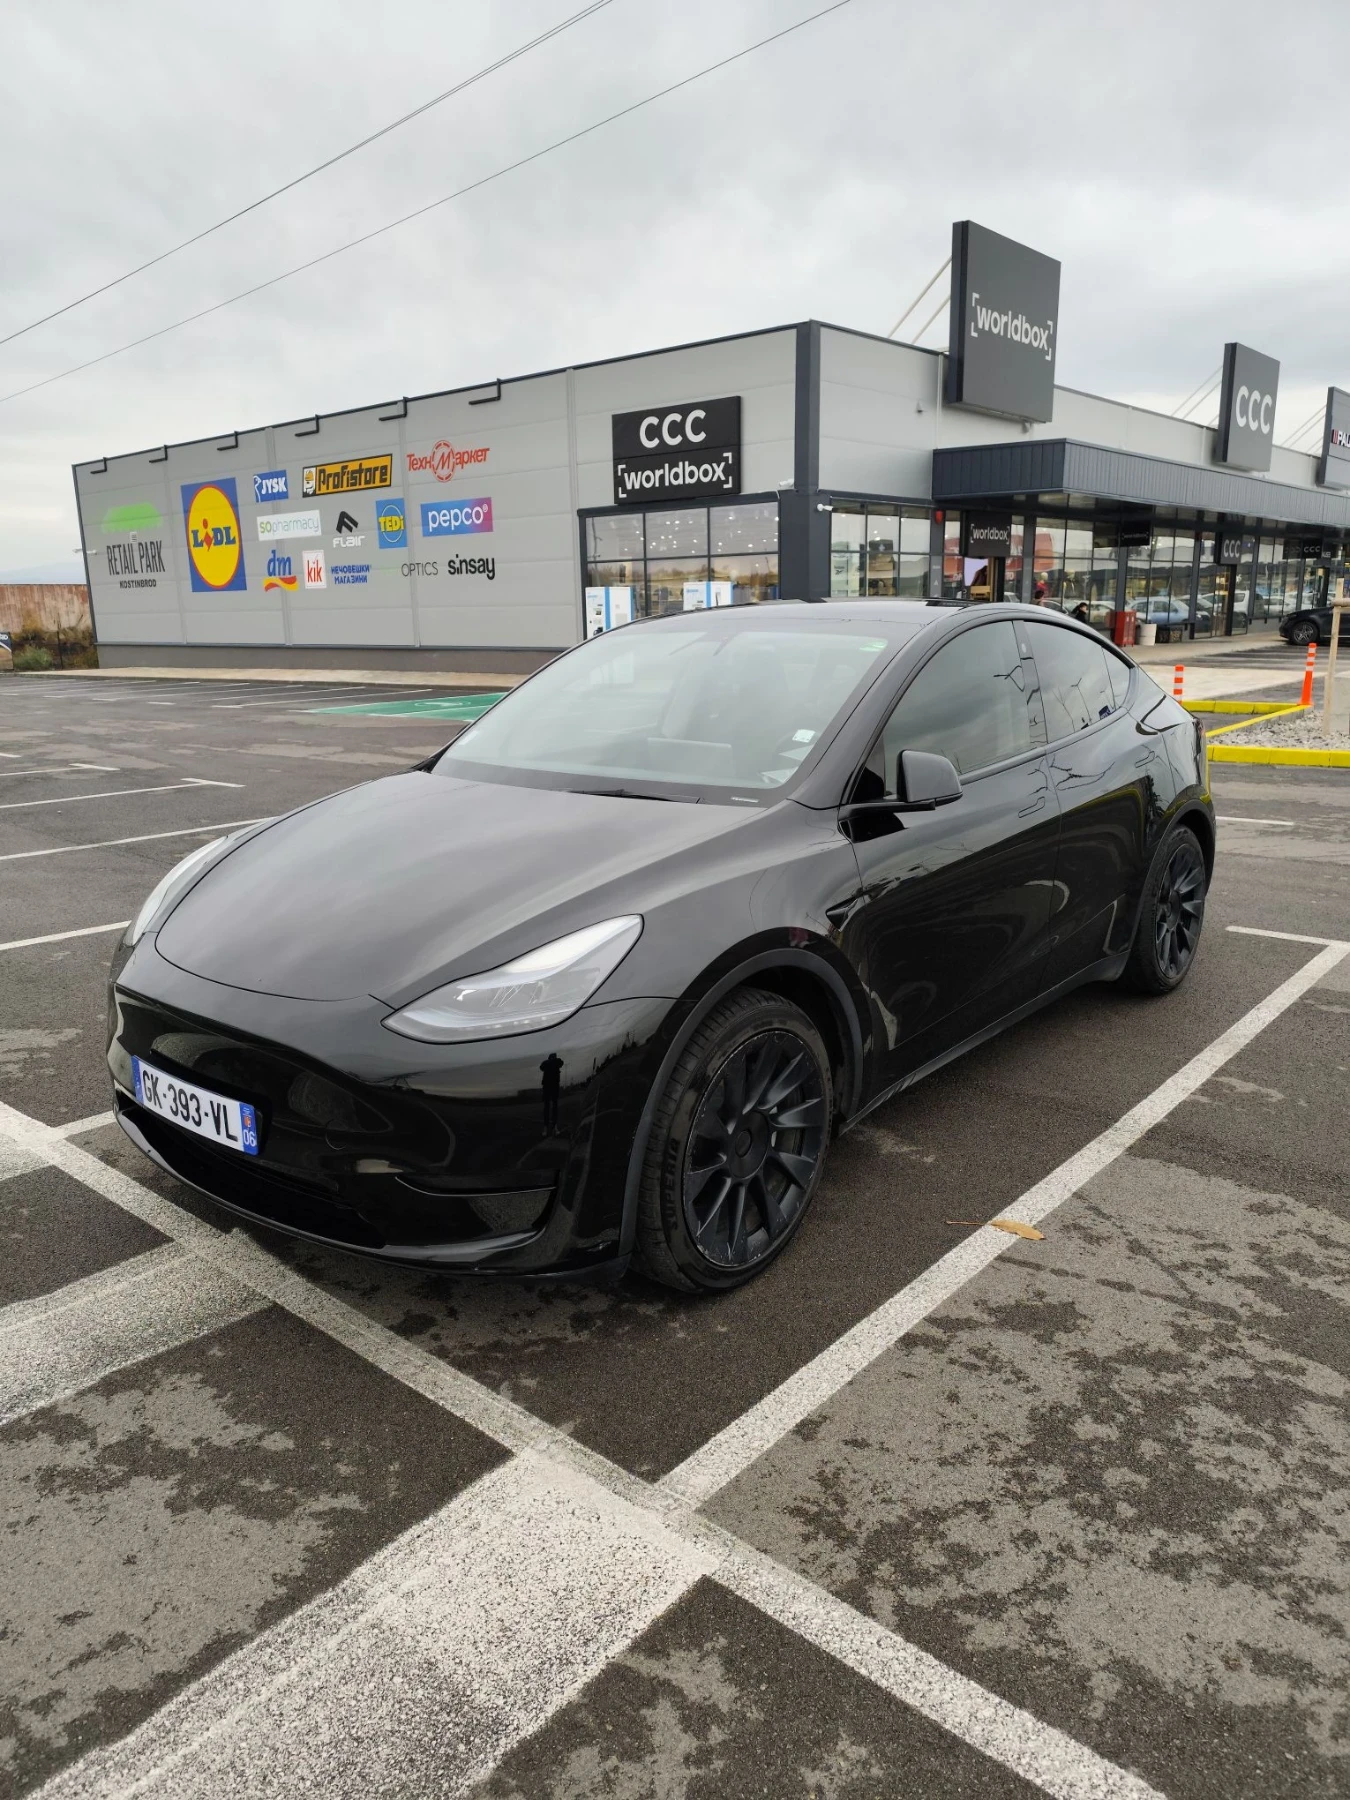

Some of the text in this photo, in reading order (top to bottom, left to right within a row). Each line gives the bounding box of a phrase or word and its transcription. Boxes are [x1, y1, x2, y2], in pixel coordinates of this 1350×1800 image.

[976, 304, 1050, 351] worldbox
[1235, 385, 1273, 435] CCC
[639, 409, 707, 449] CCC
[261, 476, 287, 495] JYSK
[318, 462, 388, 491] Profistore
[623, 460, 726, 490] worldbox
[259, 517, 319, 535] sopharmacy
[972, 525, 1008, 541] worldbox
[107, 540, 165, 576] RETAIL PARK
[1223, 539, 1241, 558] CCC
[267, 550, 292, 577] dm
[307, 559, 322, 583] kik
[401, 561, 438, 577] OPTICS
[448, 554, 495, 580] sinsay
[120, 579, 156, 588] KOSTINBROD
[243, 1129, 256, 1147] 06
